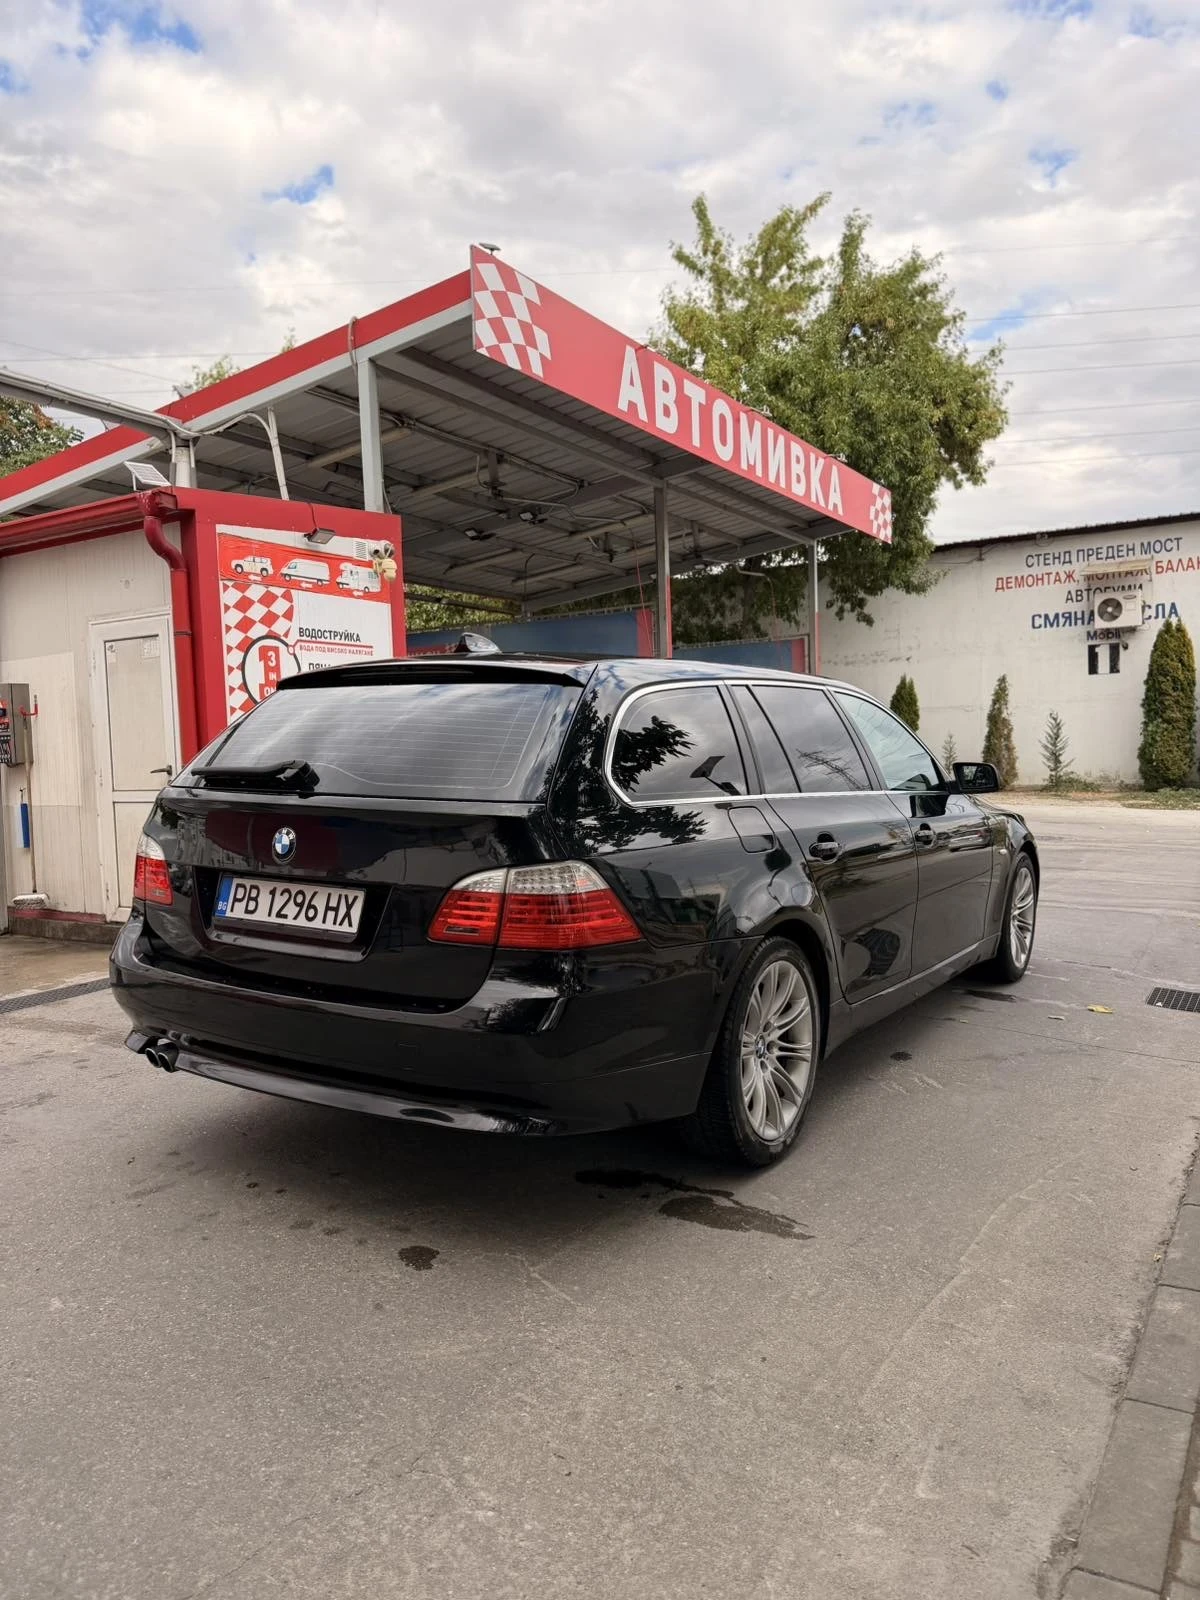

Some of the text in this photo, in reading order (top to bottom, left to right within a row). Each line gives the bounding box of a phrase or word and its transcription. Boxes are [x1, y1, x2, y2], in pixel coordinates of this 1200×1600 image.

[618, 345, 844, 516] АВТОМИВКА
[1025, 537, 1183, 568] СТЕНД ПРЕДЕН МОСТ
[995, 569, 1080, 592] ДЕМОНТАЖ,
[1031, 610, 1095, 629] СМЯНА
[299, 627, 361, 642] ВОДОСТРУЙКА
[1086, 628, 1121, 641] Mobil
[267, 651, 277, 667] 3
[217, 883, 359, 928] BG PB 1296 HX
